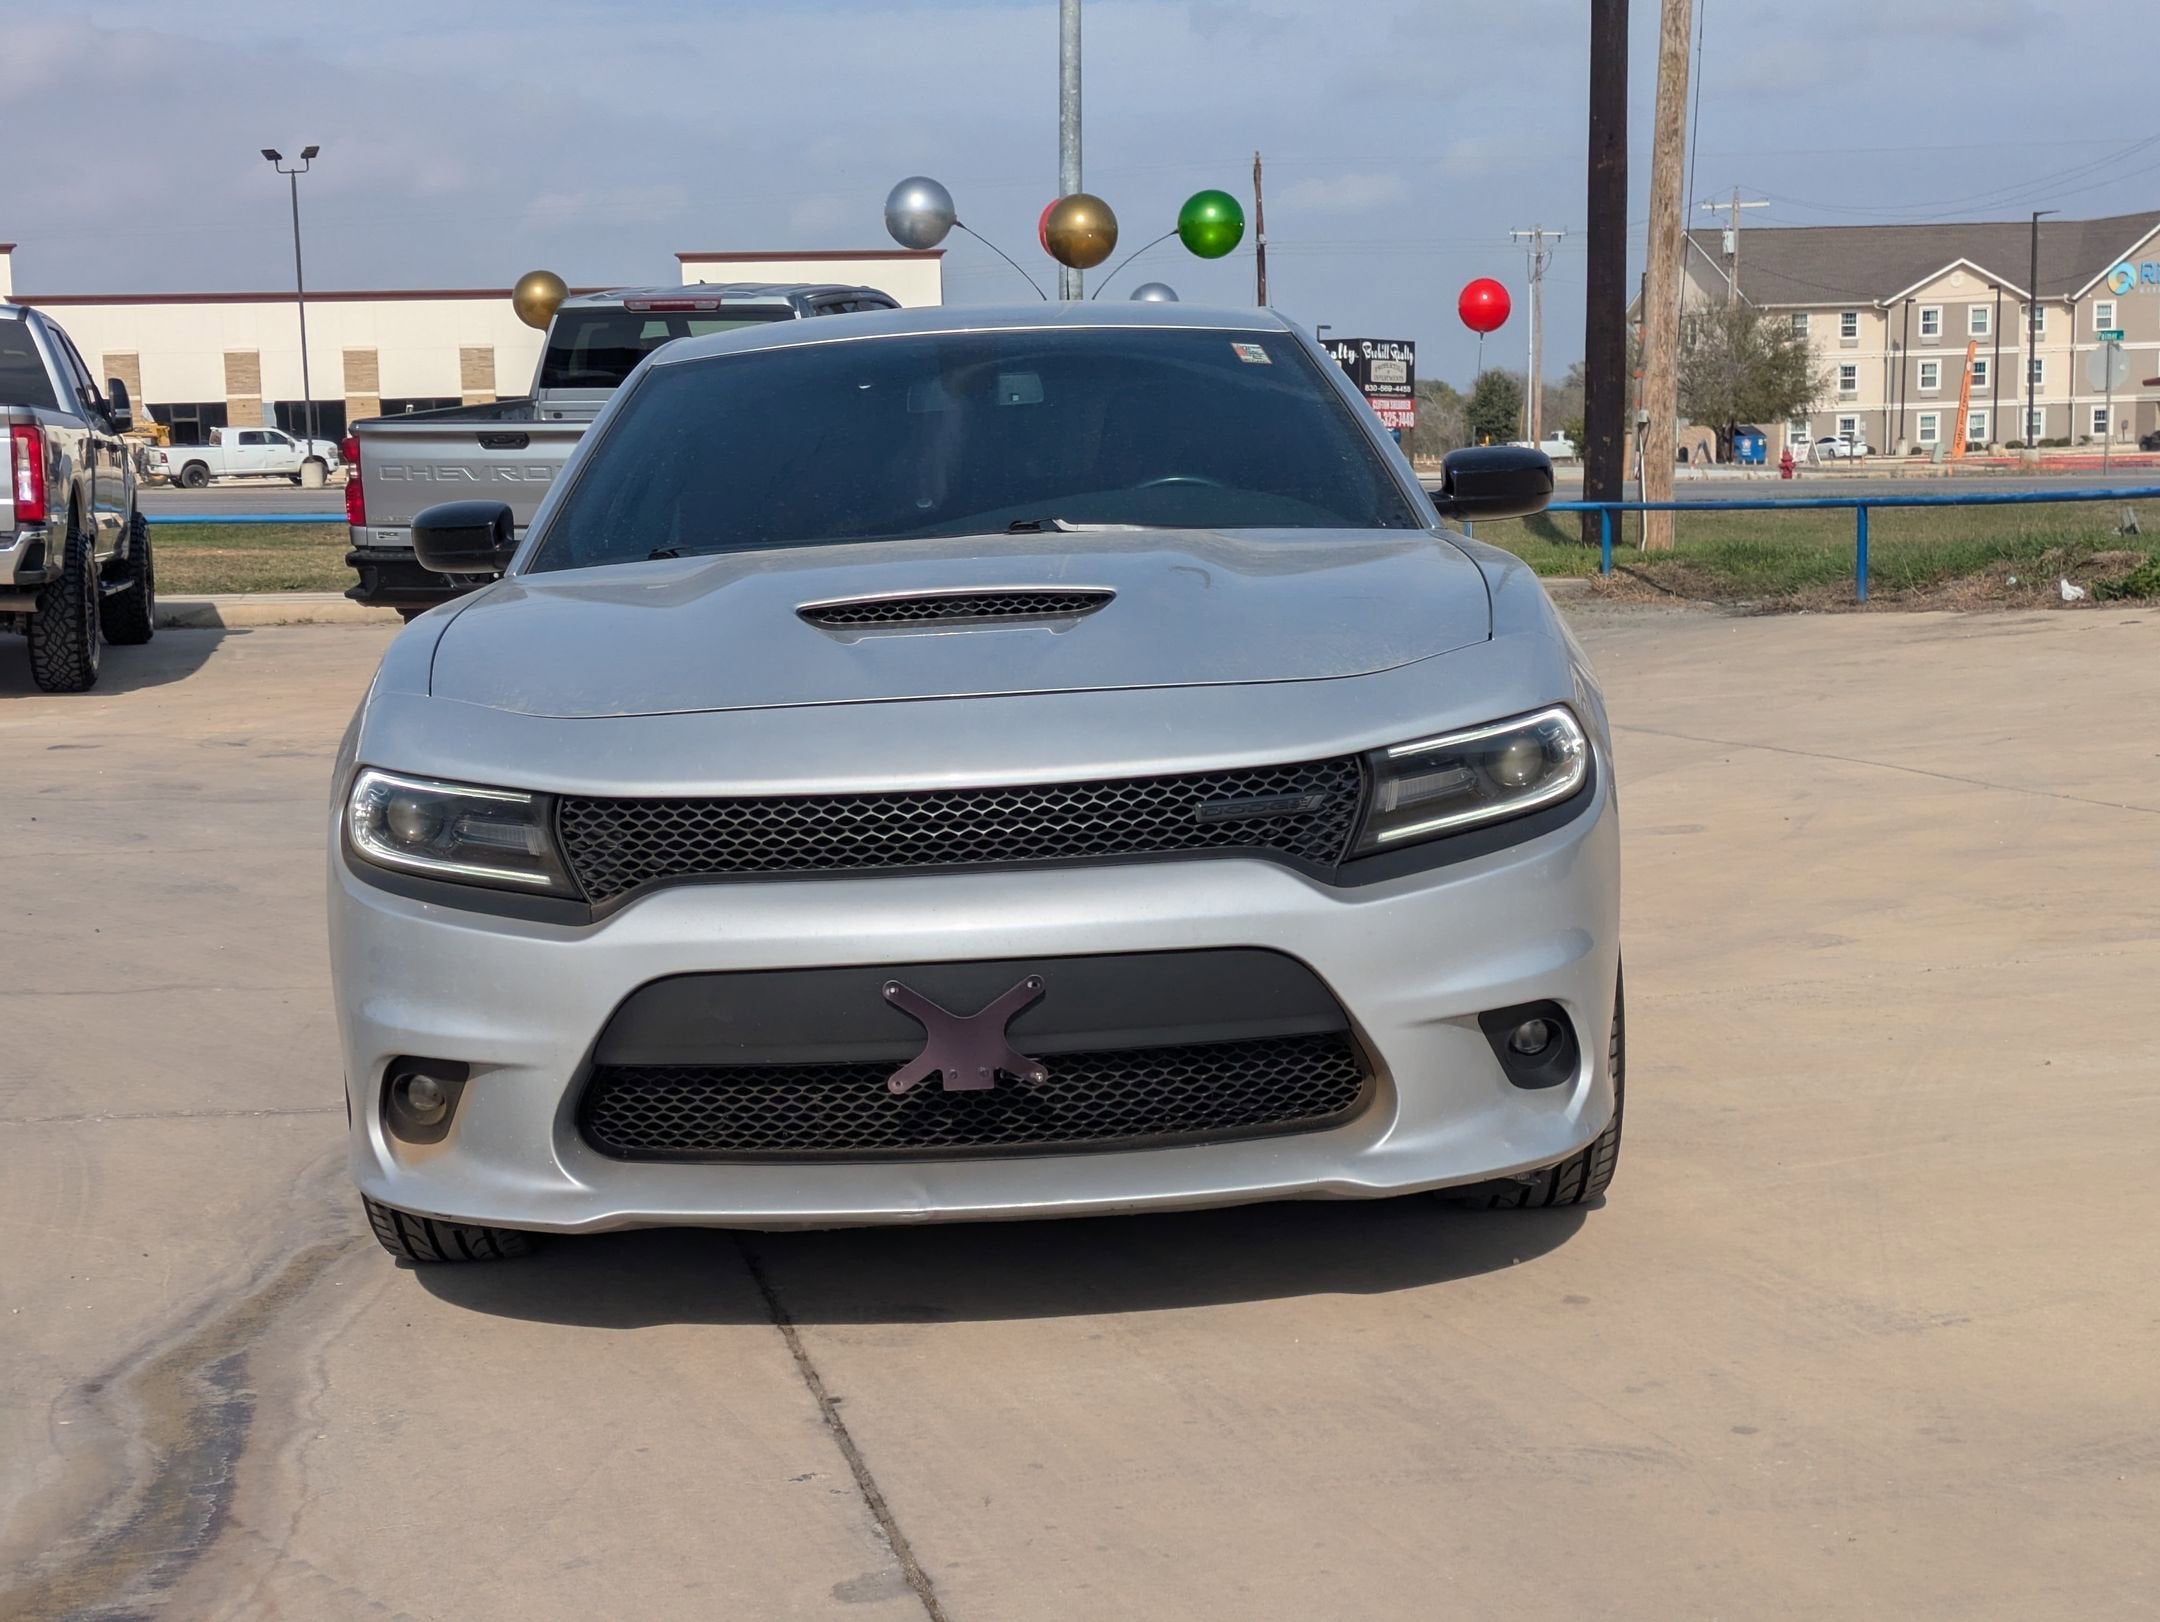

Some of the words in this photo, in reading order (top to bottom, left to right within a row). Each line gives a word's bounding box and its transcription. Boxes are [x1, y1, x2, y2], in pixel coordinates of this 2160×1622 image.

[2141, 262, 2160, 284] R
[379, 465, 562, 482] CHEVRO
[1203, 799, 1299, 815] DODGE
